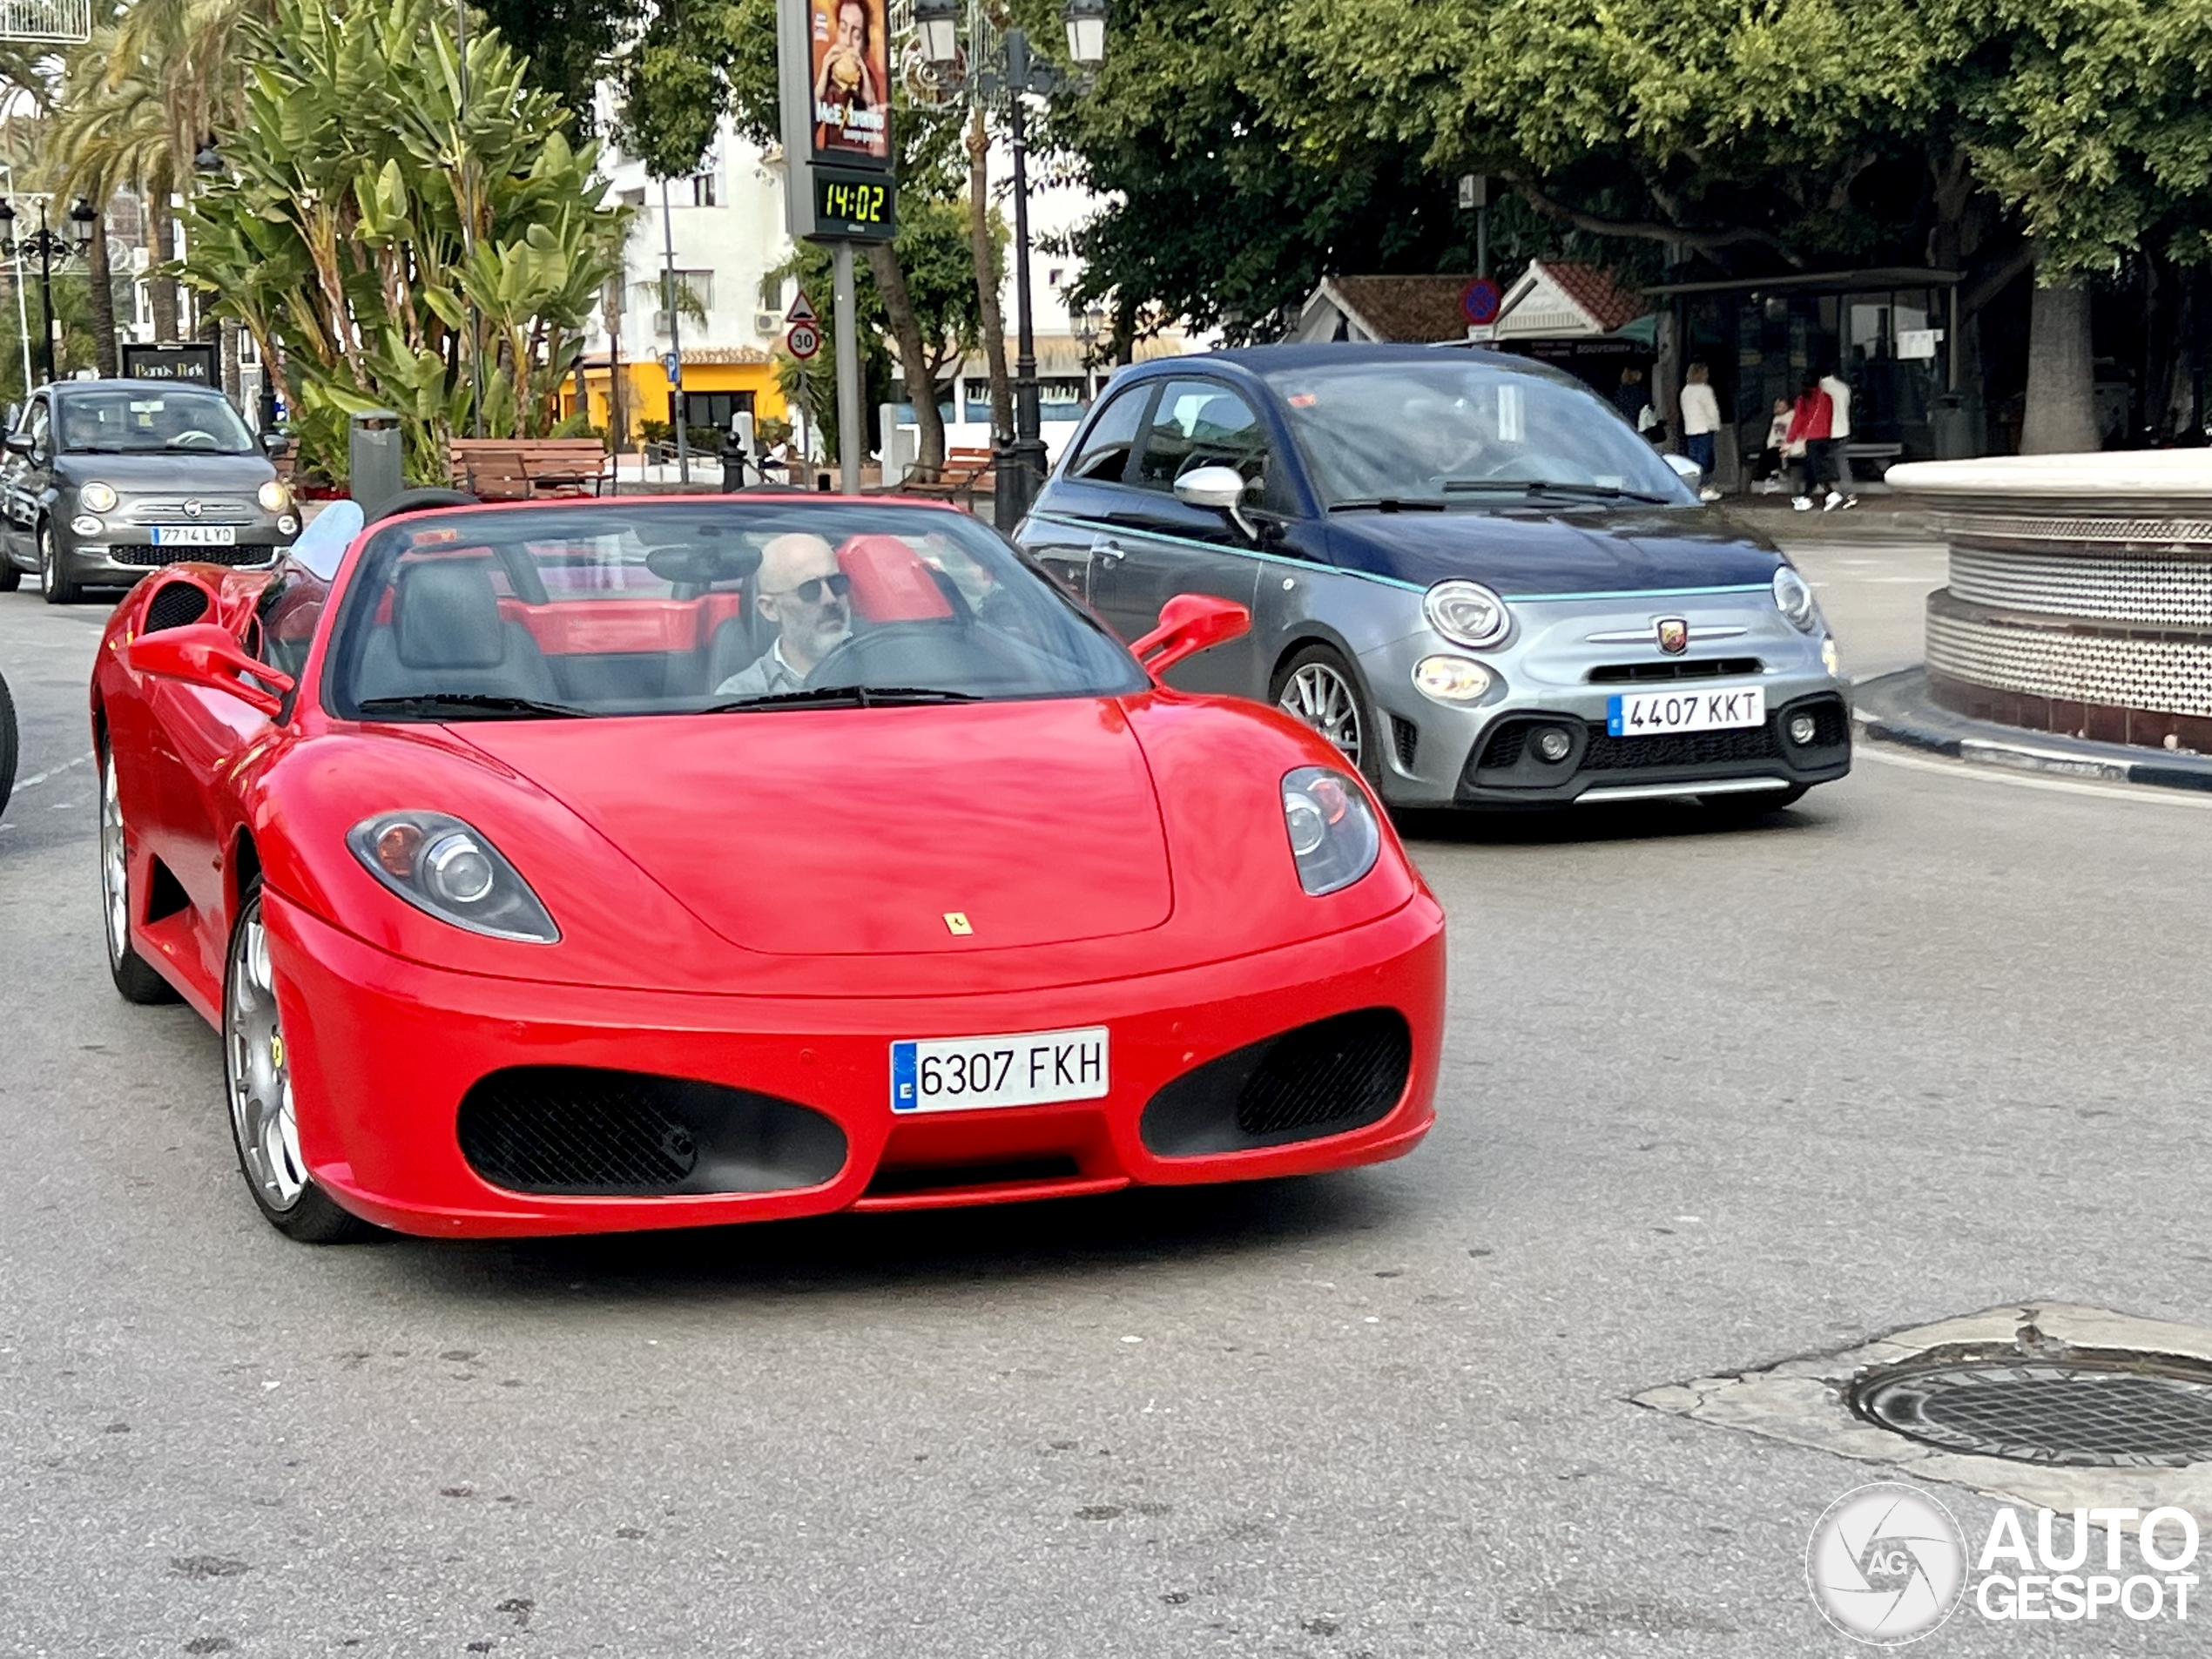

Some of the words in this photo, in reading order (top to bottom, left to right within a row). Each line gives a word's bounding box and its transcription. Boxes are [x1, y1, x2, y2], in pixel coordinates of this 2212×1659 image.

[826, 184, 884, 222] 14:02
[795, 334, 813, 348] 30
[163, 529, 199, 542] 7714
[204, 529, 232, 542] LYD
[1630, 698, 1698, 728] 4407
[1709, 692, 1756, 723] KKT
[921, 1050, 1014, 1096] 6307
[1030, 1042, 1101, 1089] FKH
